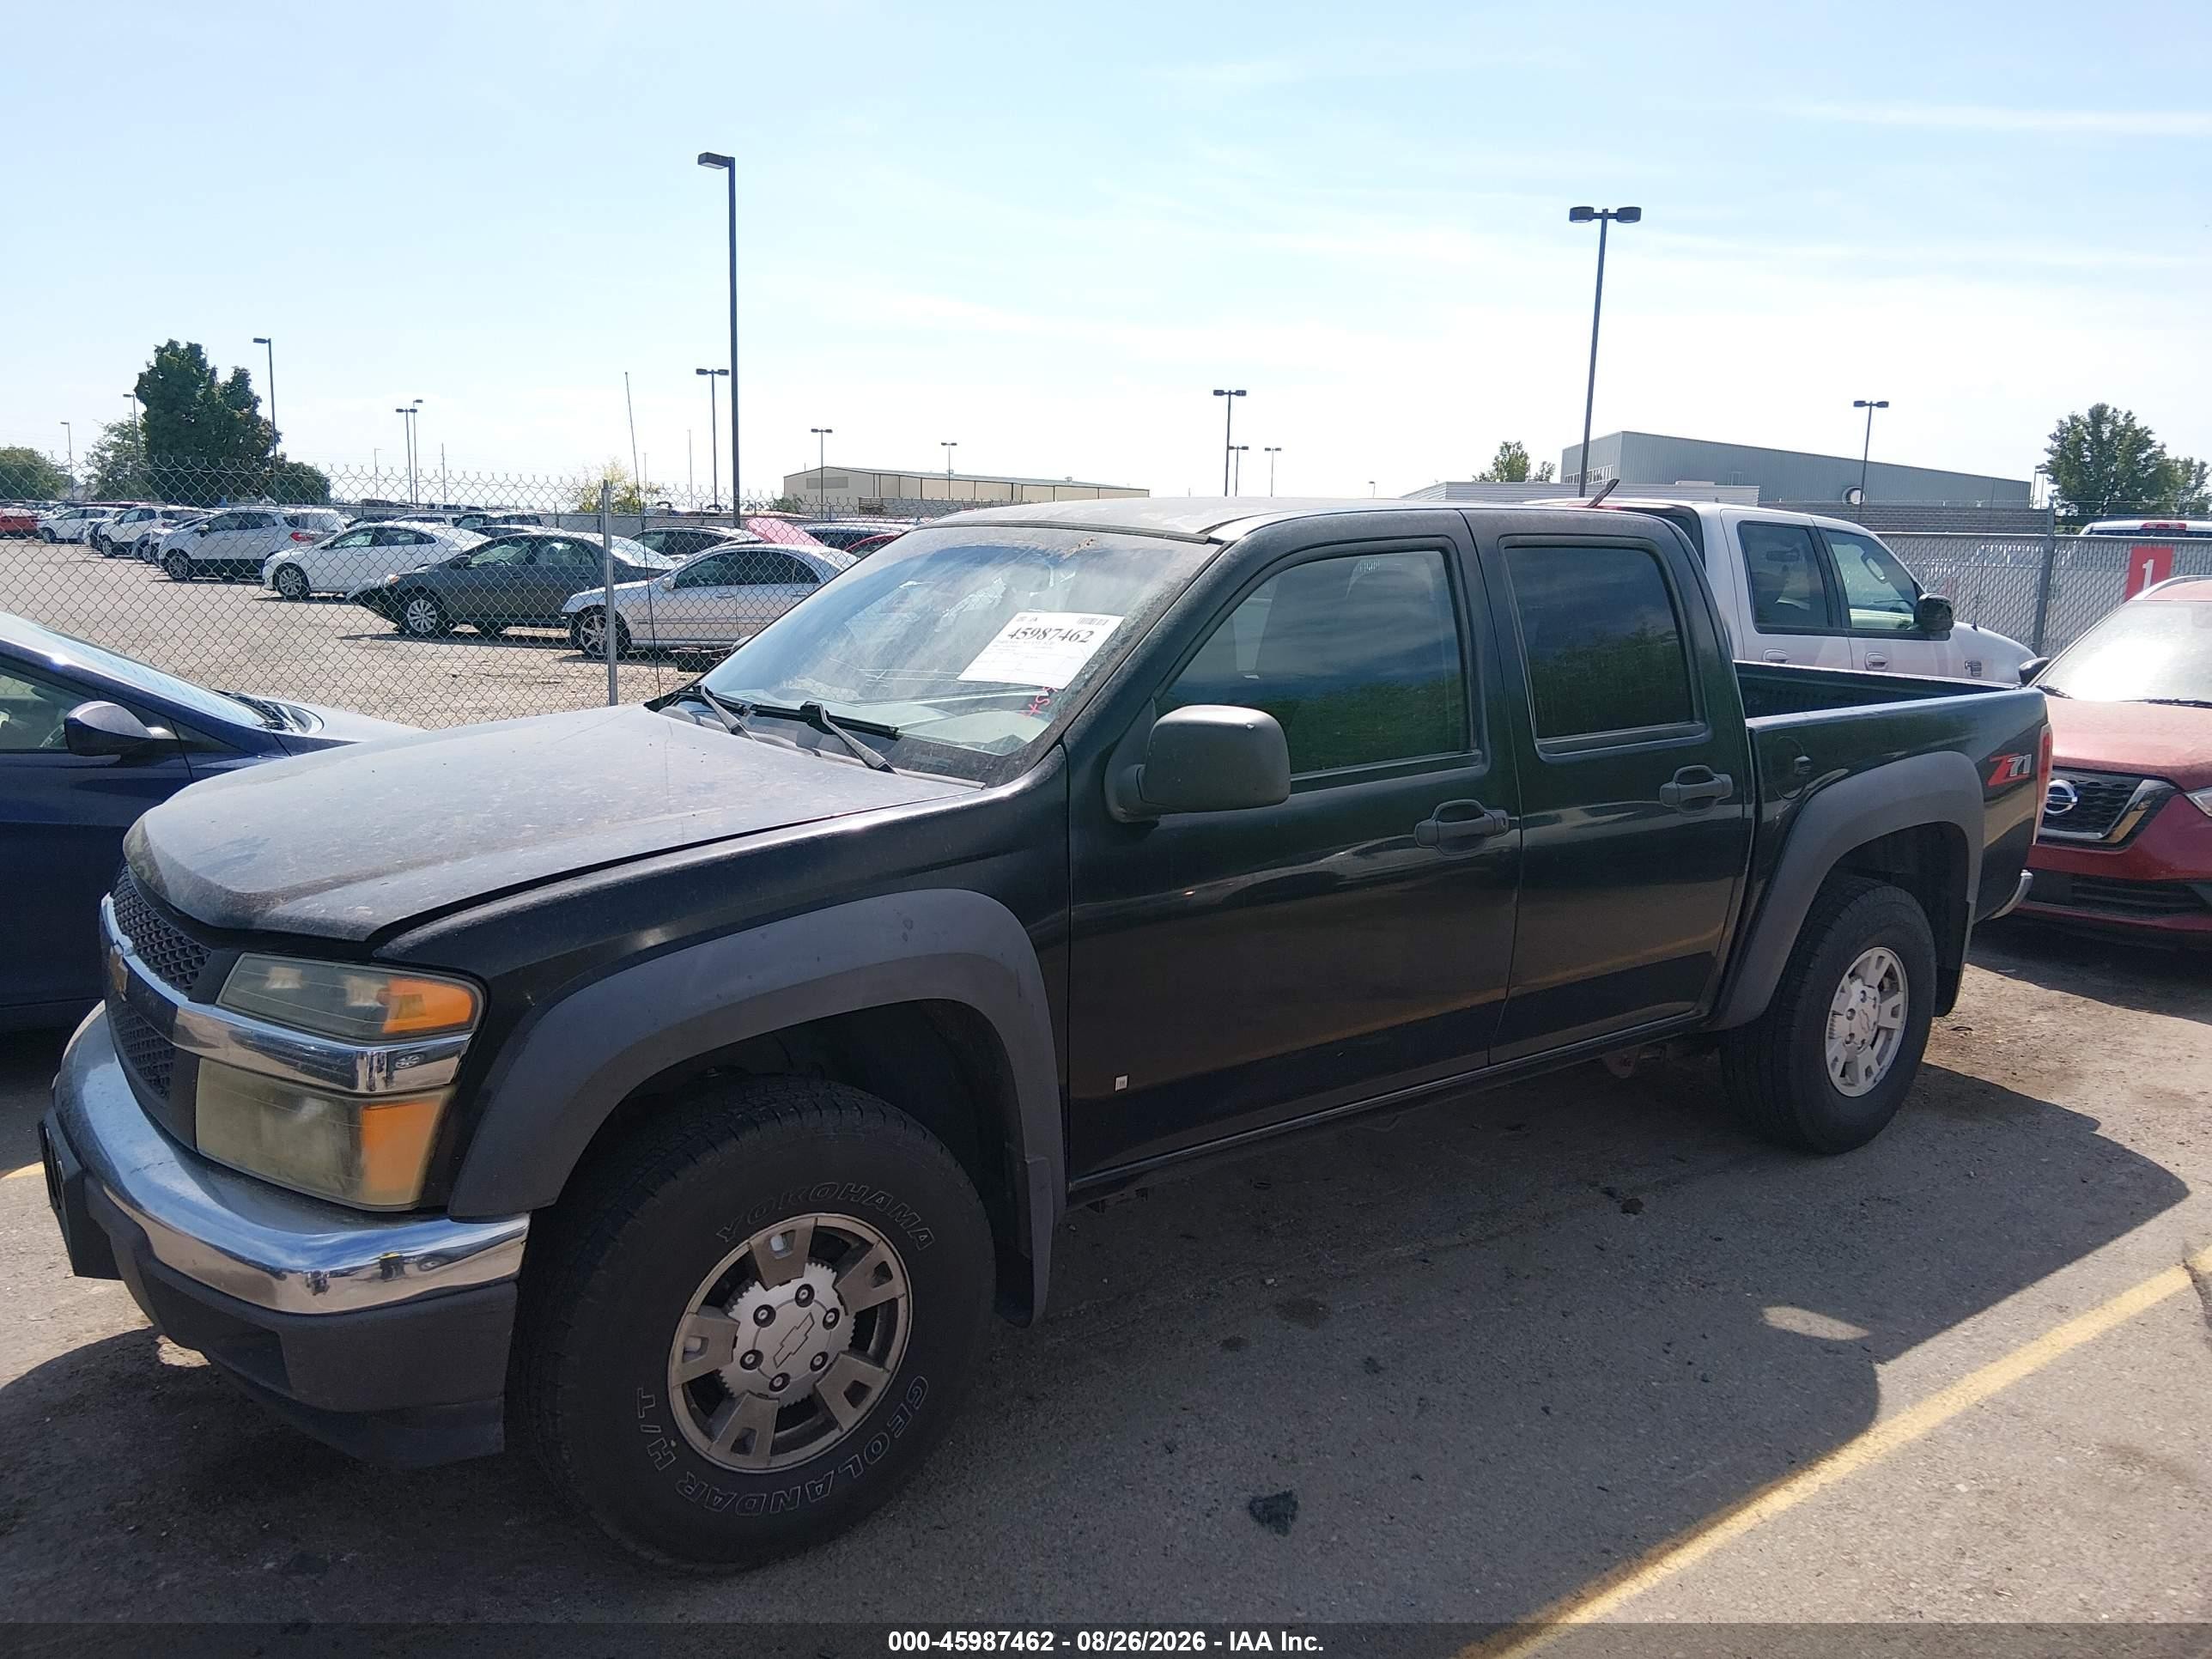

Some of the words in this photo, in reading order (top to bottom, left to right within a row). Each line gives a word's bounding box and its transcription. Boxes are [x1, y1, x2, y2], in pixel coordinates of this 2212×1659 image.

[2142, 558, 2154, 591] 1
[1006, 627, 1095, 643] 45987462
[1987, 752, 2033, 788] Z71
[714, 1182, 935, 1250] YOKOHAMA
[676, 1376, 929, 1516] GEOLANDAR
